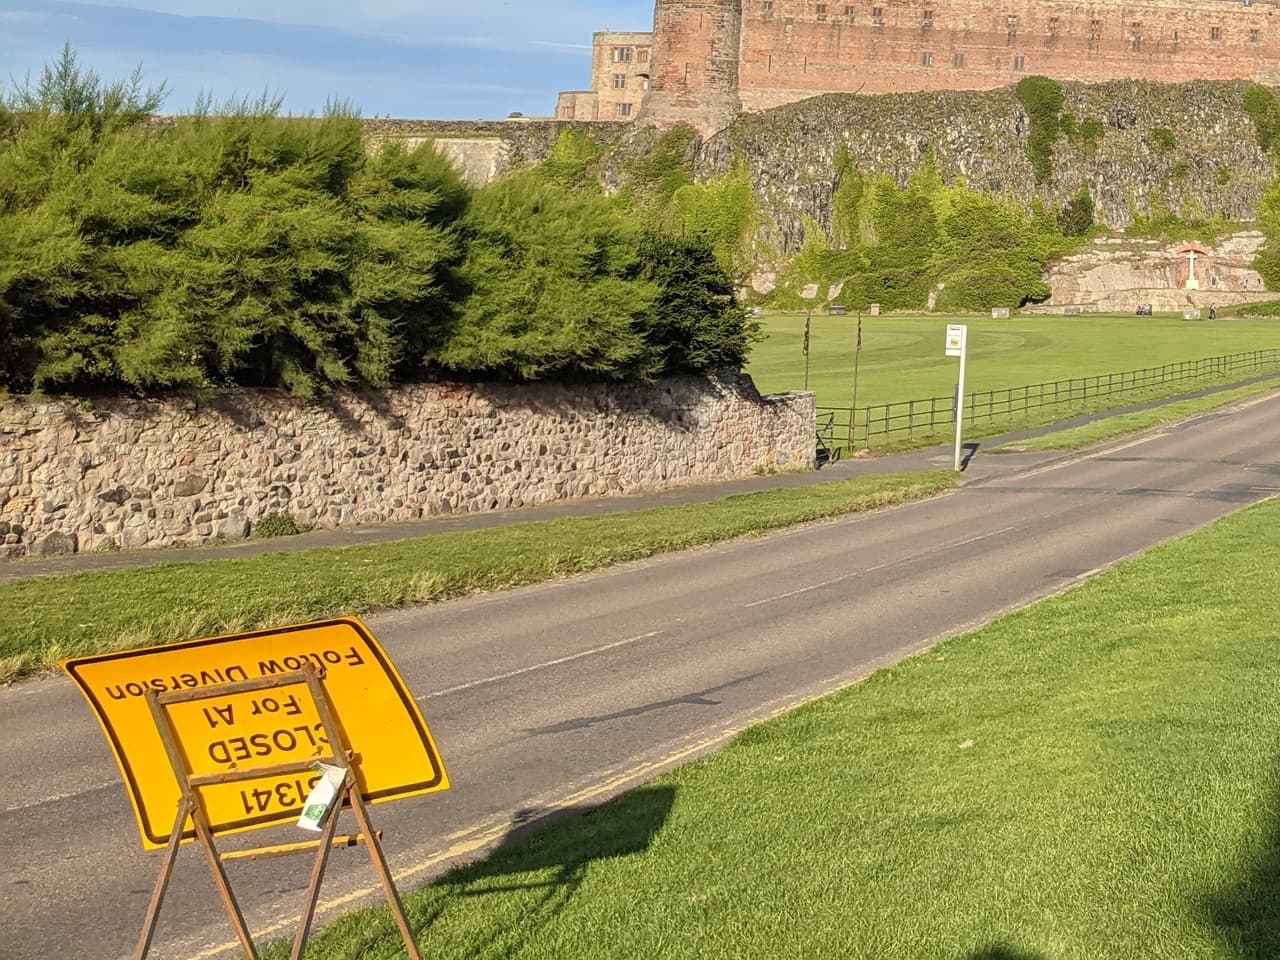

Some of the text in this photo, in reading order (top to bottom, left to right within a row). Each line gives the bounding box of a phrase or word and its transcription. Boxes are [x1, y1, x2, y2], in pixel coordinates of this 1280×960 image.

[258, 646, 365, 676] Folow
[202, 695, 302, 728] For A1
